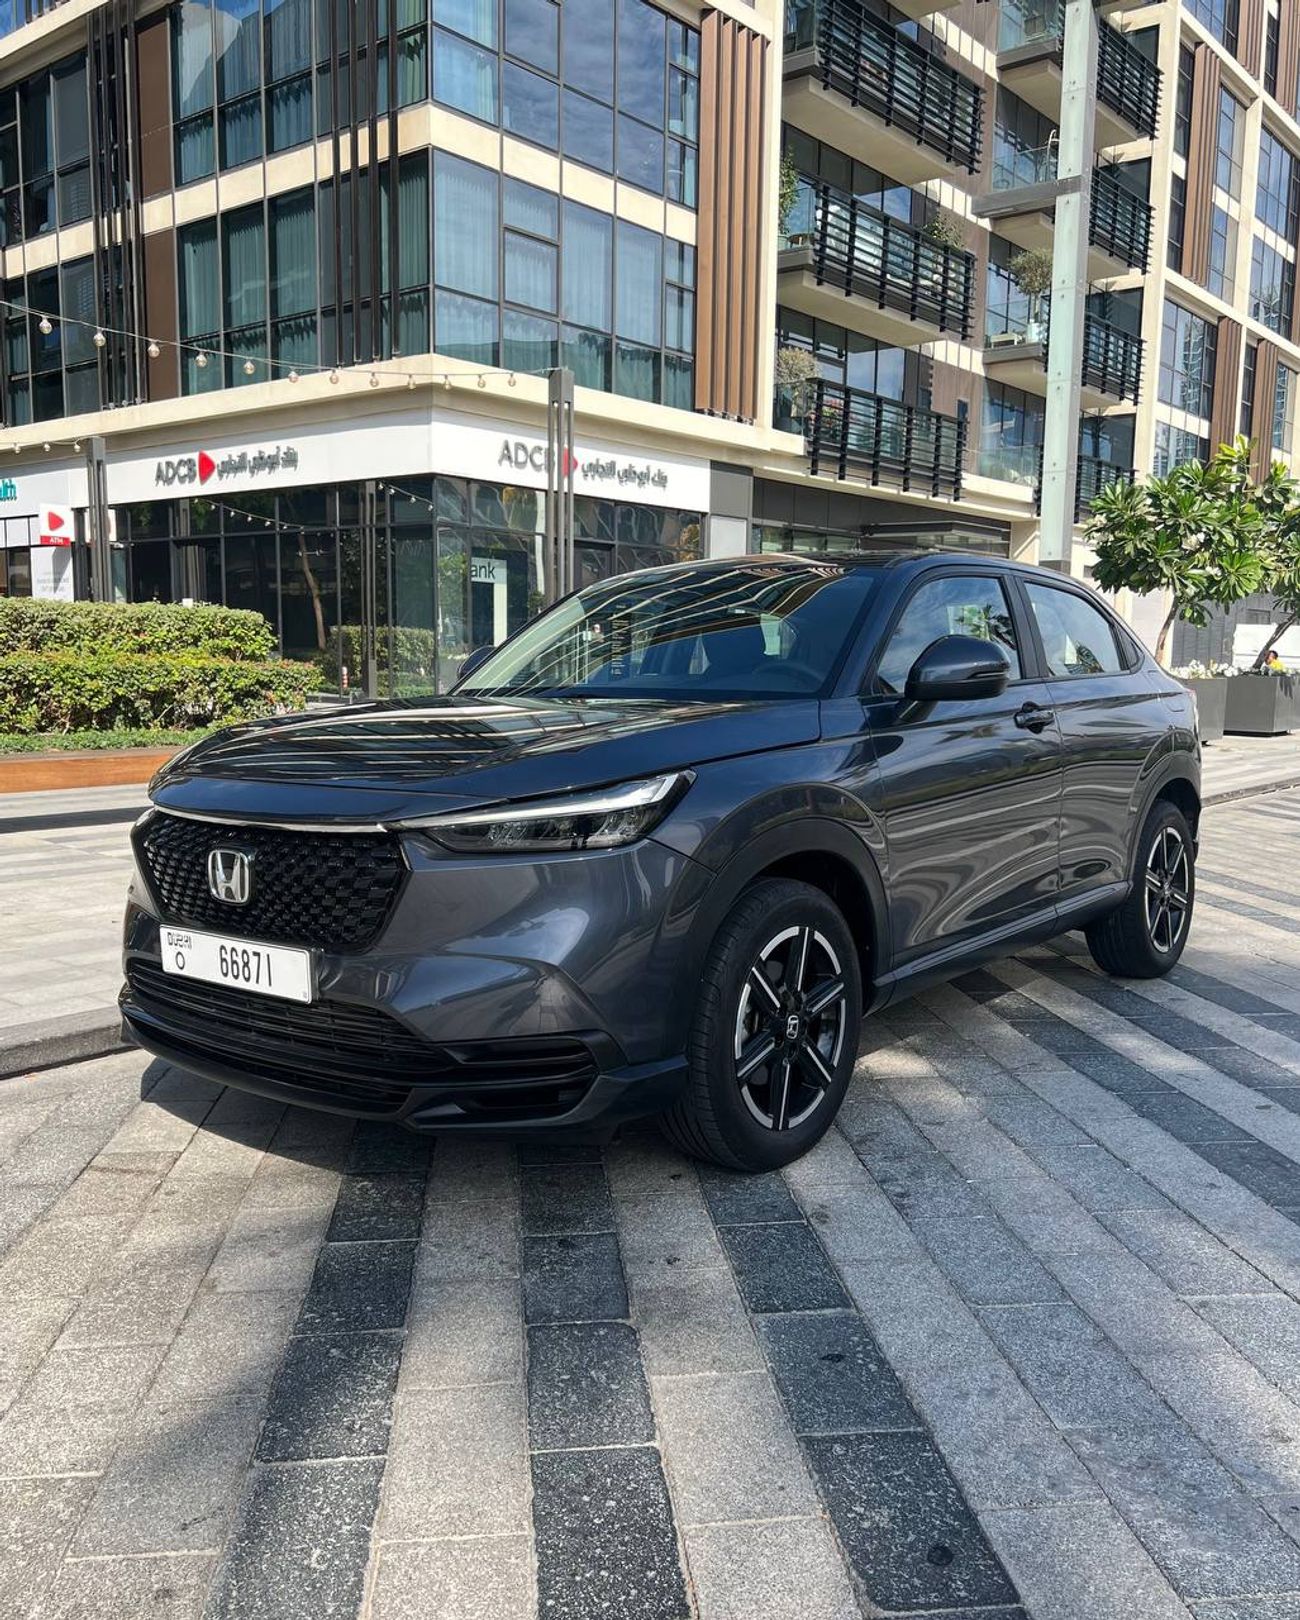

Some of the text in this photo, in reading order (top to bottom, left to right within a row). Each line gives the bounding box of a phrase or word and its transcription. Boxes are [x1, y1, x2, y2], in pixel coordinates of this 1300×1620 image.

[155, 457, 197, 487] ADCB
[0, 478, 17, 501] lth
[219, 944, 272, 987] 66871
